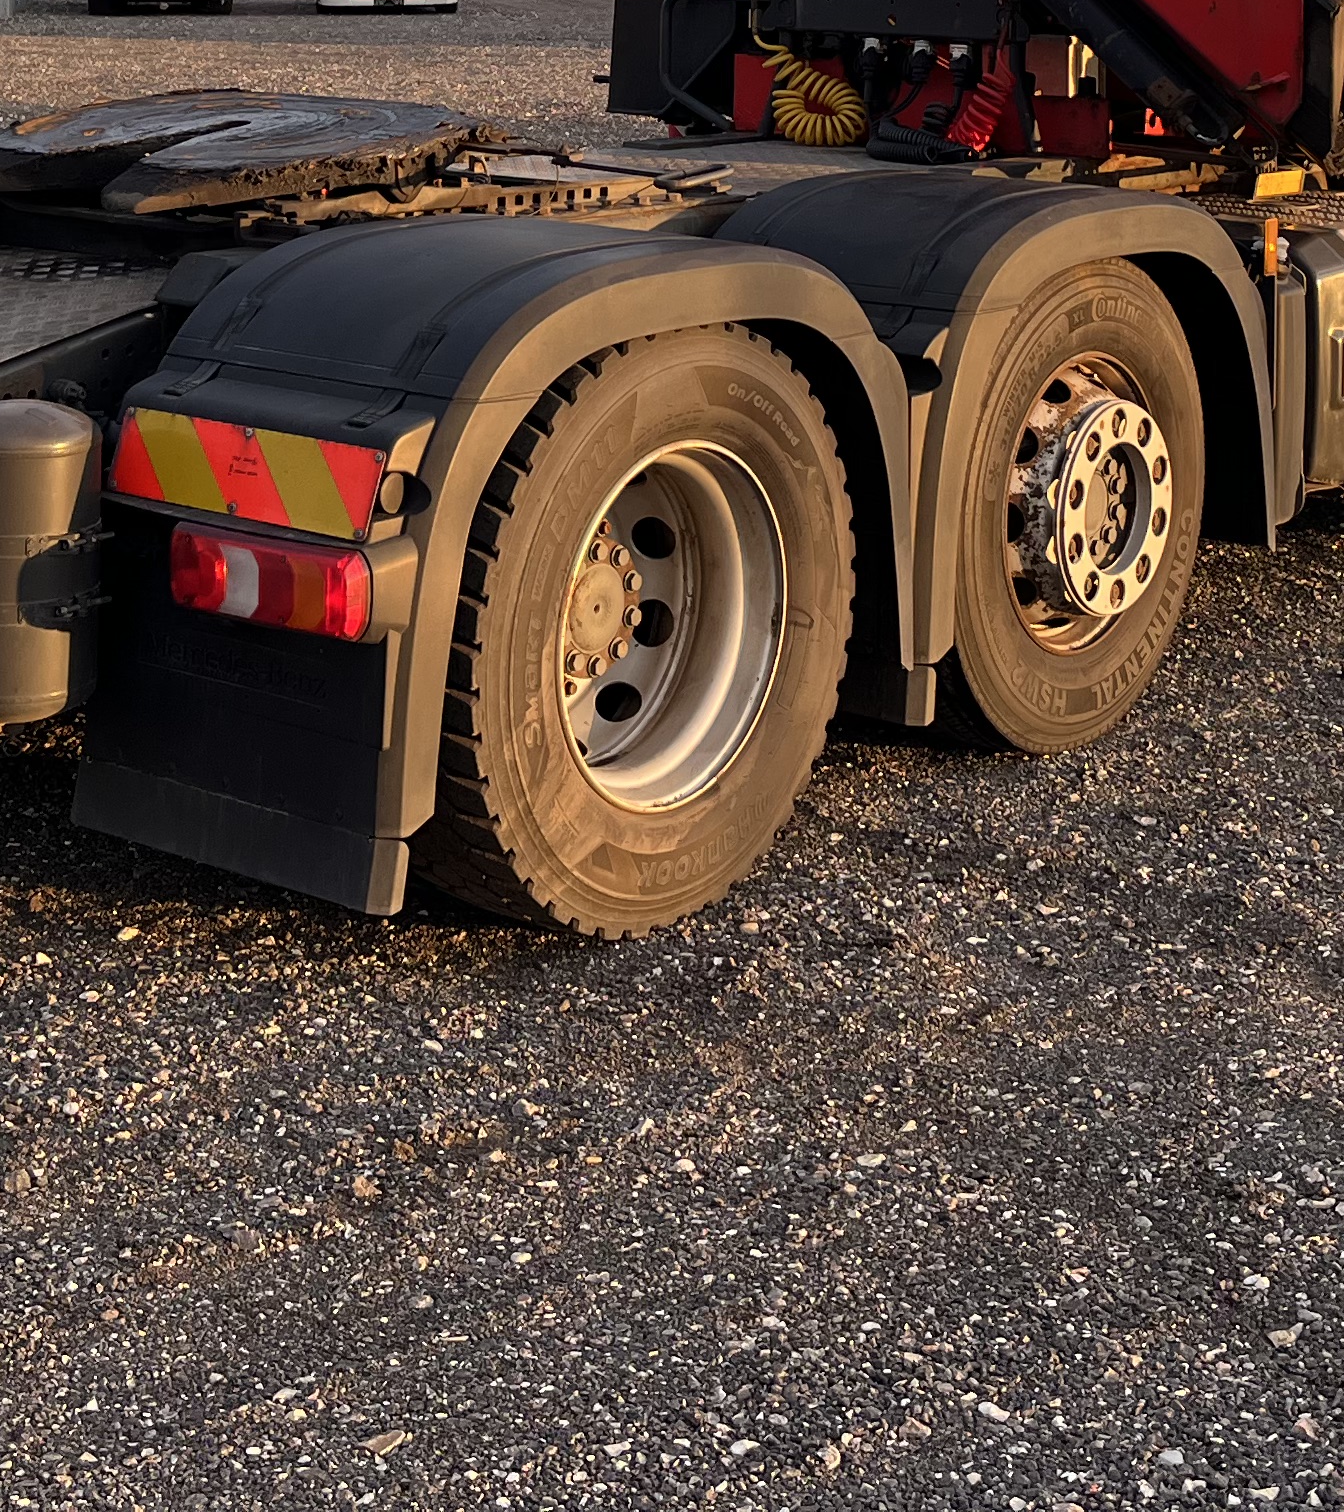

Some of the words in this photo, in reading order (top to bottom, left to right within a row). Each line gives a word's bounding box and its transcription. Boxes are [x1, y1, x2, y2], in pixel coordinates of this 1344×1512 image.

[727, 382, 775, 416] On/Off
[772, 411, 801, 448] Road
[1091, 506, 1195, 710] CONTINENTAL
[1010, 661, 1068, 717] HSW2
